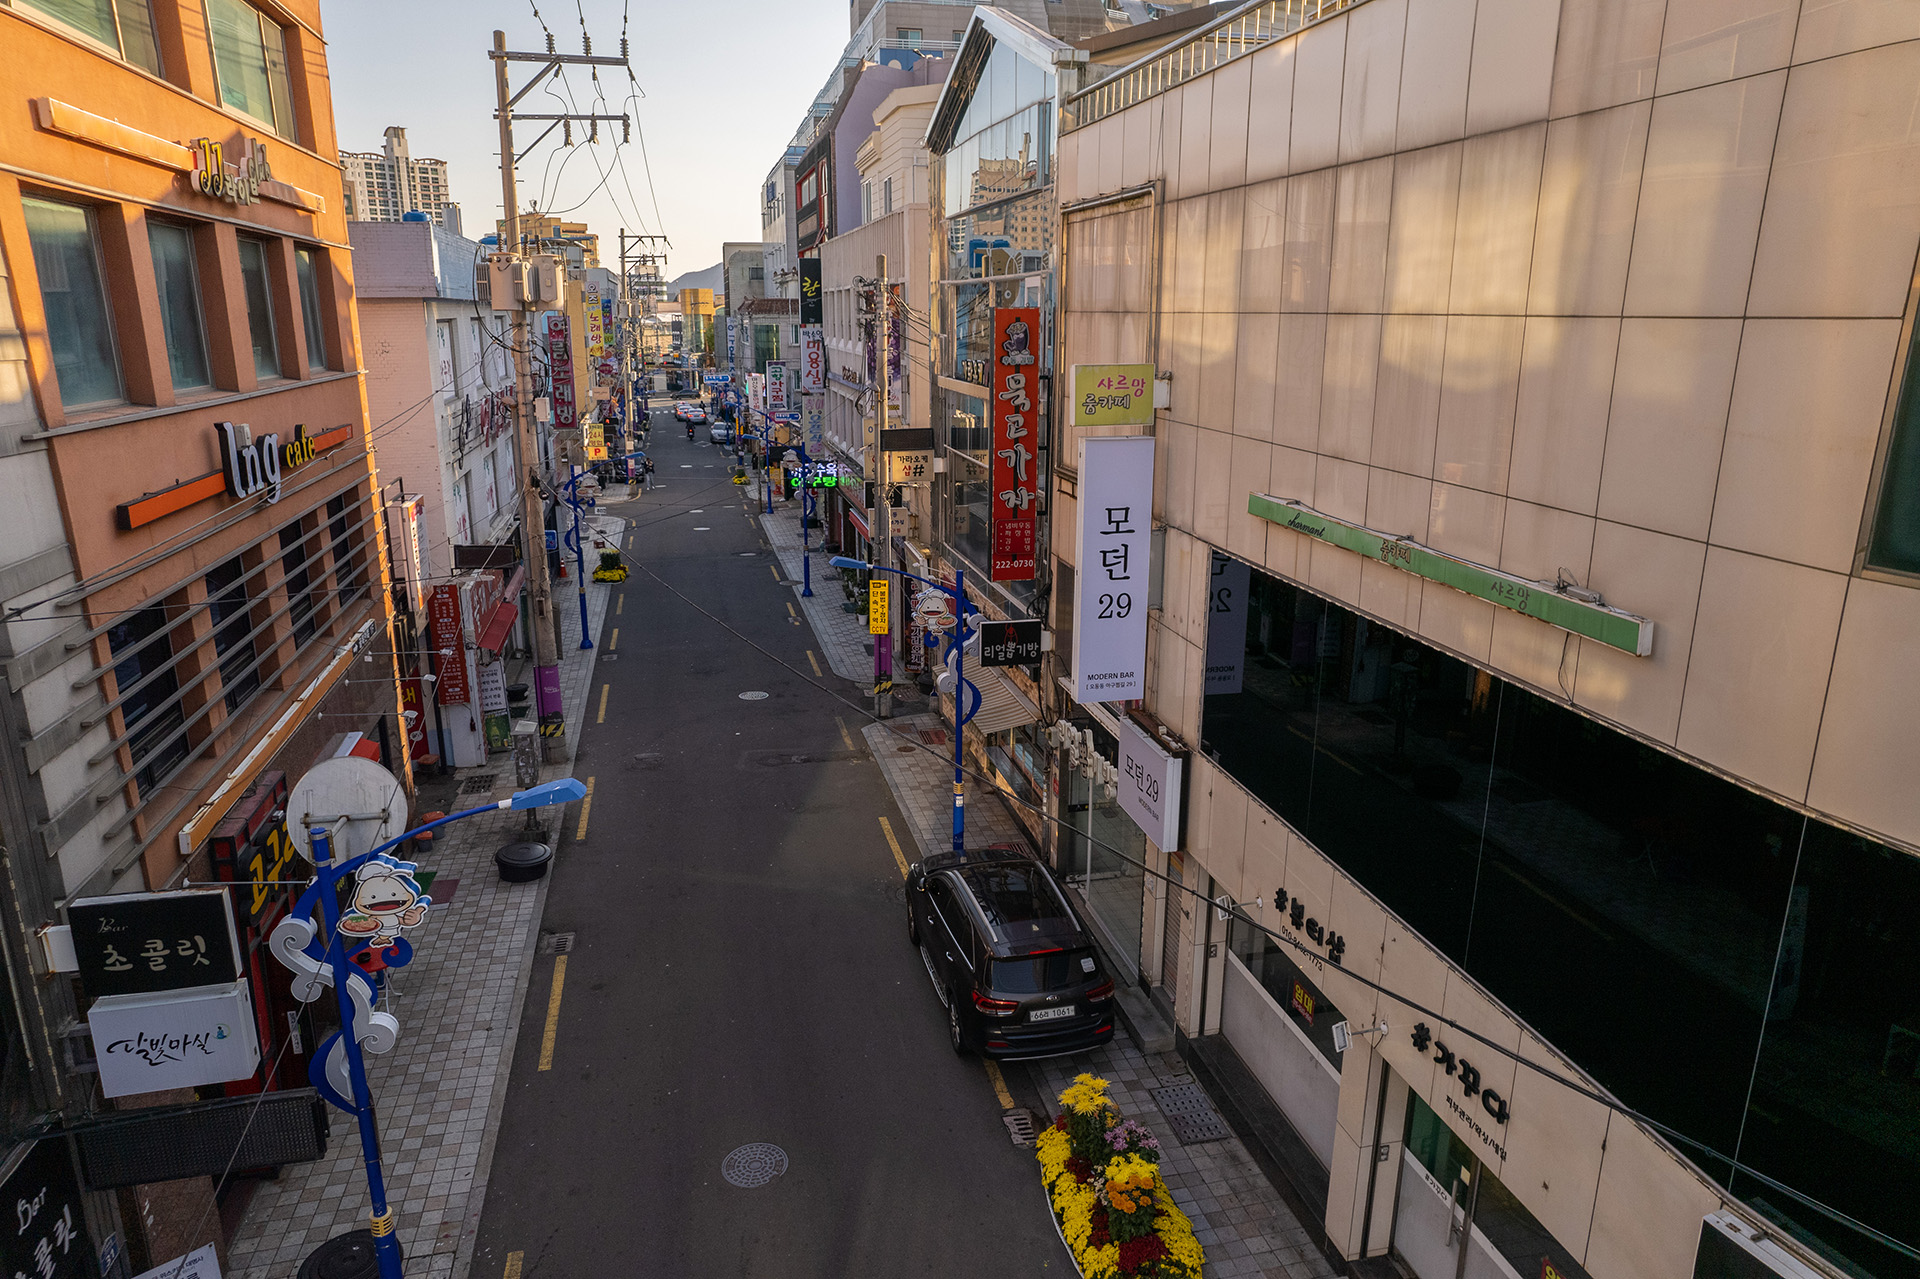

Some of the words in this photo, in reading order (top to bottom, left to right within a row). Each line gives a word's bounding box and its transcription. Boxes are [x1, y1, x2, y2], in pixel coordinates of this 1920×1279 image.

[589, 312, 603, 344] 노래방
[807, 341, 821, 386] 미용실
[1097, 374, 1146, 398] 샤르망
[1082, 393, 1130, 415] 룸카페
[286, 424, 316, 468] cafe
[594, 448, 601, 456] P
[998, 373, 1035, 511] 묵고가자
[897, 455, 929, 464] 가라오케
[1287, 513, 1326, 538] charmant
[1099, 506, 1136, 580] 모던
[995, 559, 1034, 569] 222-0730
[1097, 592, 1132, 619] 29
[1491, 580, 1531, 612] 샤르망
[984, 641, 1039, 661] 리얼뽑기방
[1087, 673, 1118, 681] MODERN
[1119, 671, 1134, 679] BAR
[1125, 754, 1144, 792] 모던
[1146, 773, 1159, 803] 29
[99, 917, 129, 933] Bar
[103, 935, 210, 972] 초콜릿
[1052, 1007, 1070, 1017] 1061
[1295, 984, 1313, 1015] 임대
[106, 1031, 216, 1067] 달빛마실
